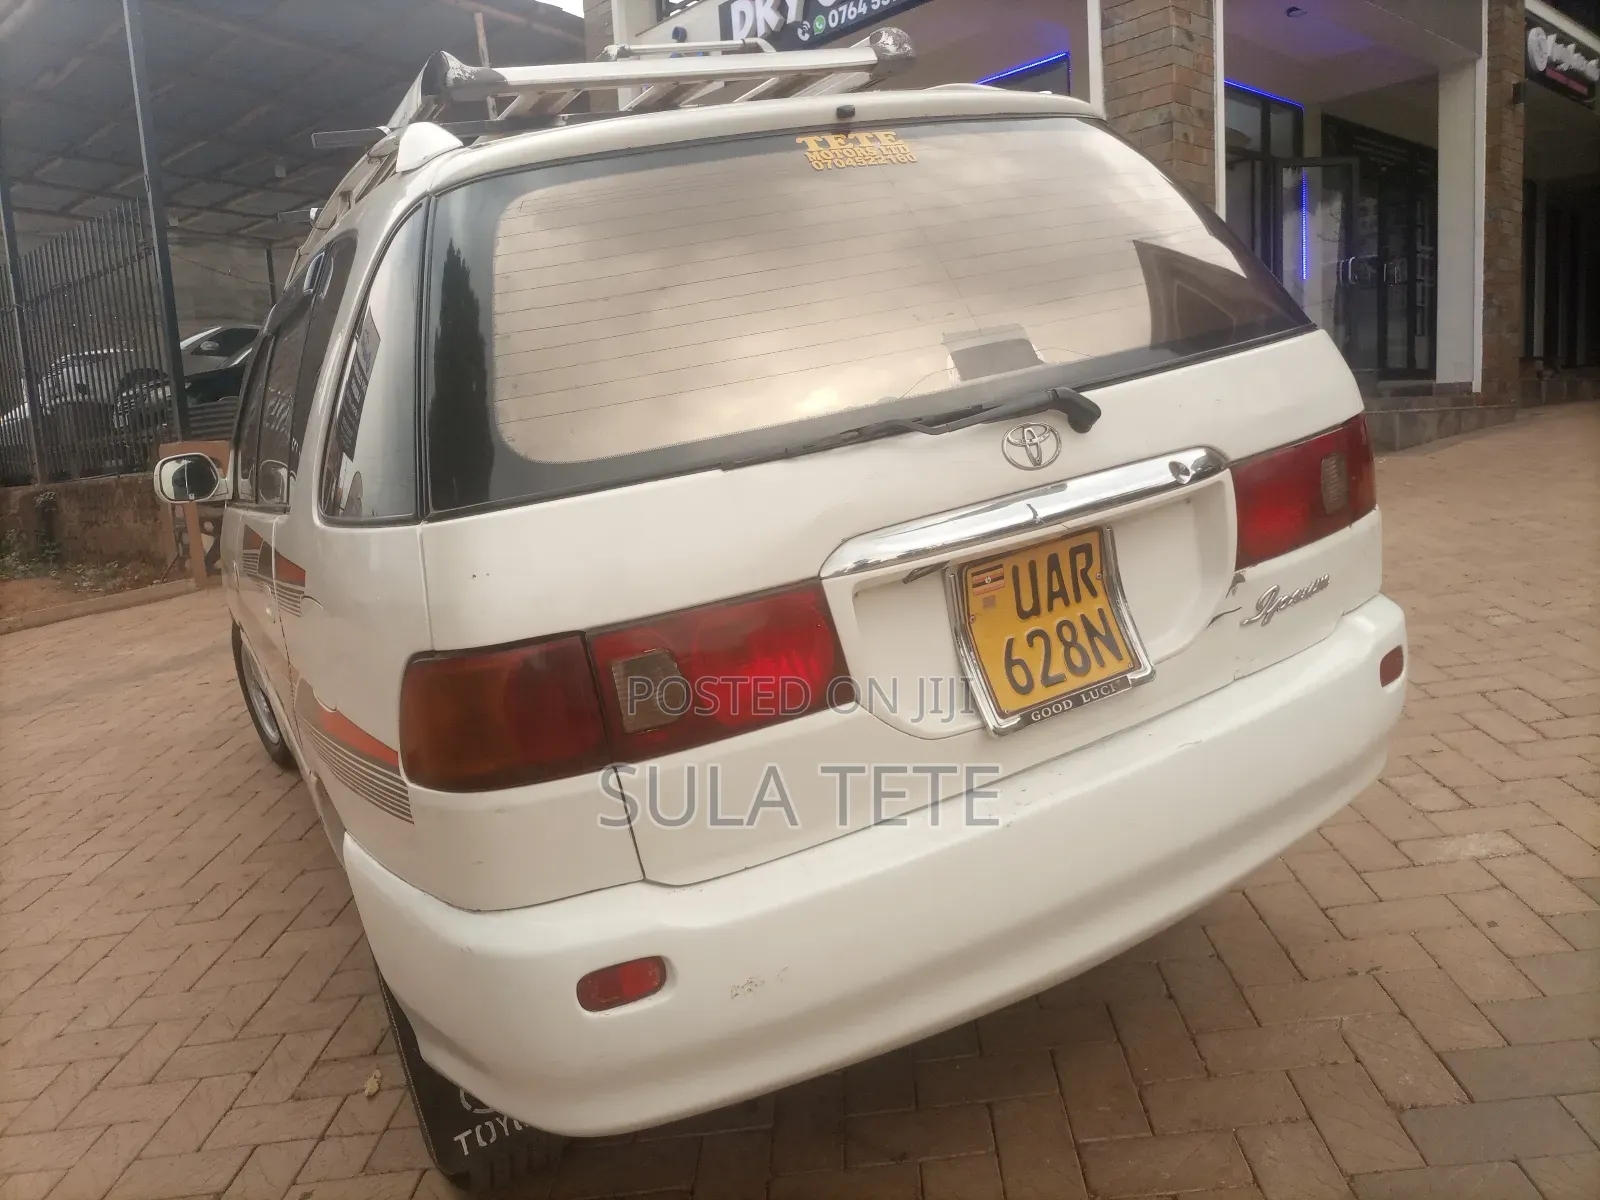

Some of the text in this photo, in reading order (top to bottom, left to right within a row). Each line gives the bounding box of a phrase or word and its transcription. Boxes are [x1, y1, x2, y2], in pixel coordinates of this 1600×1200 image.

[828, 0, 868, 28] 0764
[795, 131, 904, 152] TETE
[804, 144, 912, 161] MOTORS LTD
[1012, 542, 1099, 620] UAR
[1004, 608, 1124, 696] 628N
[1031, 699, 1073, 722] GOOD
